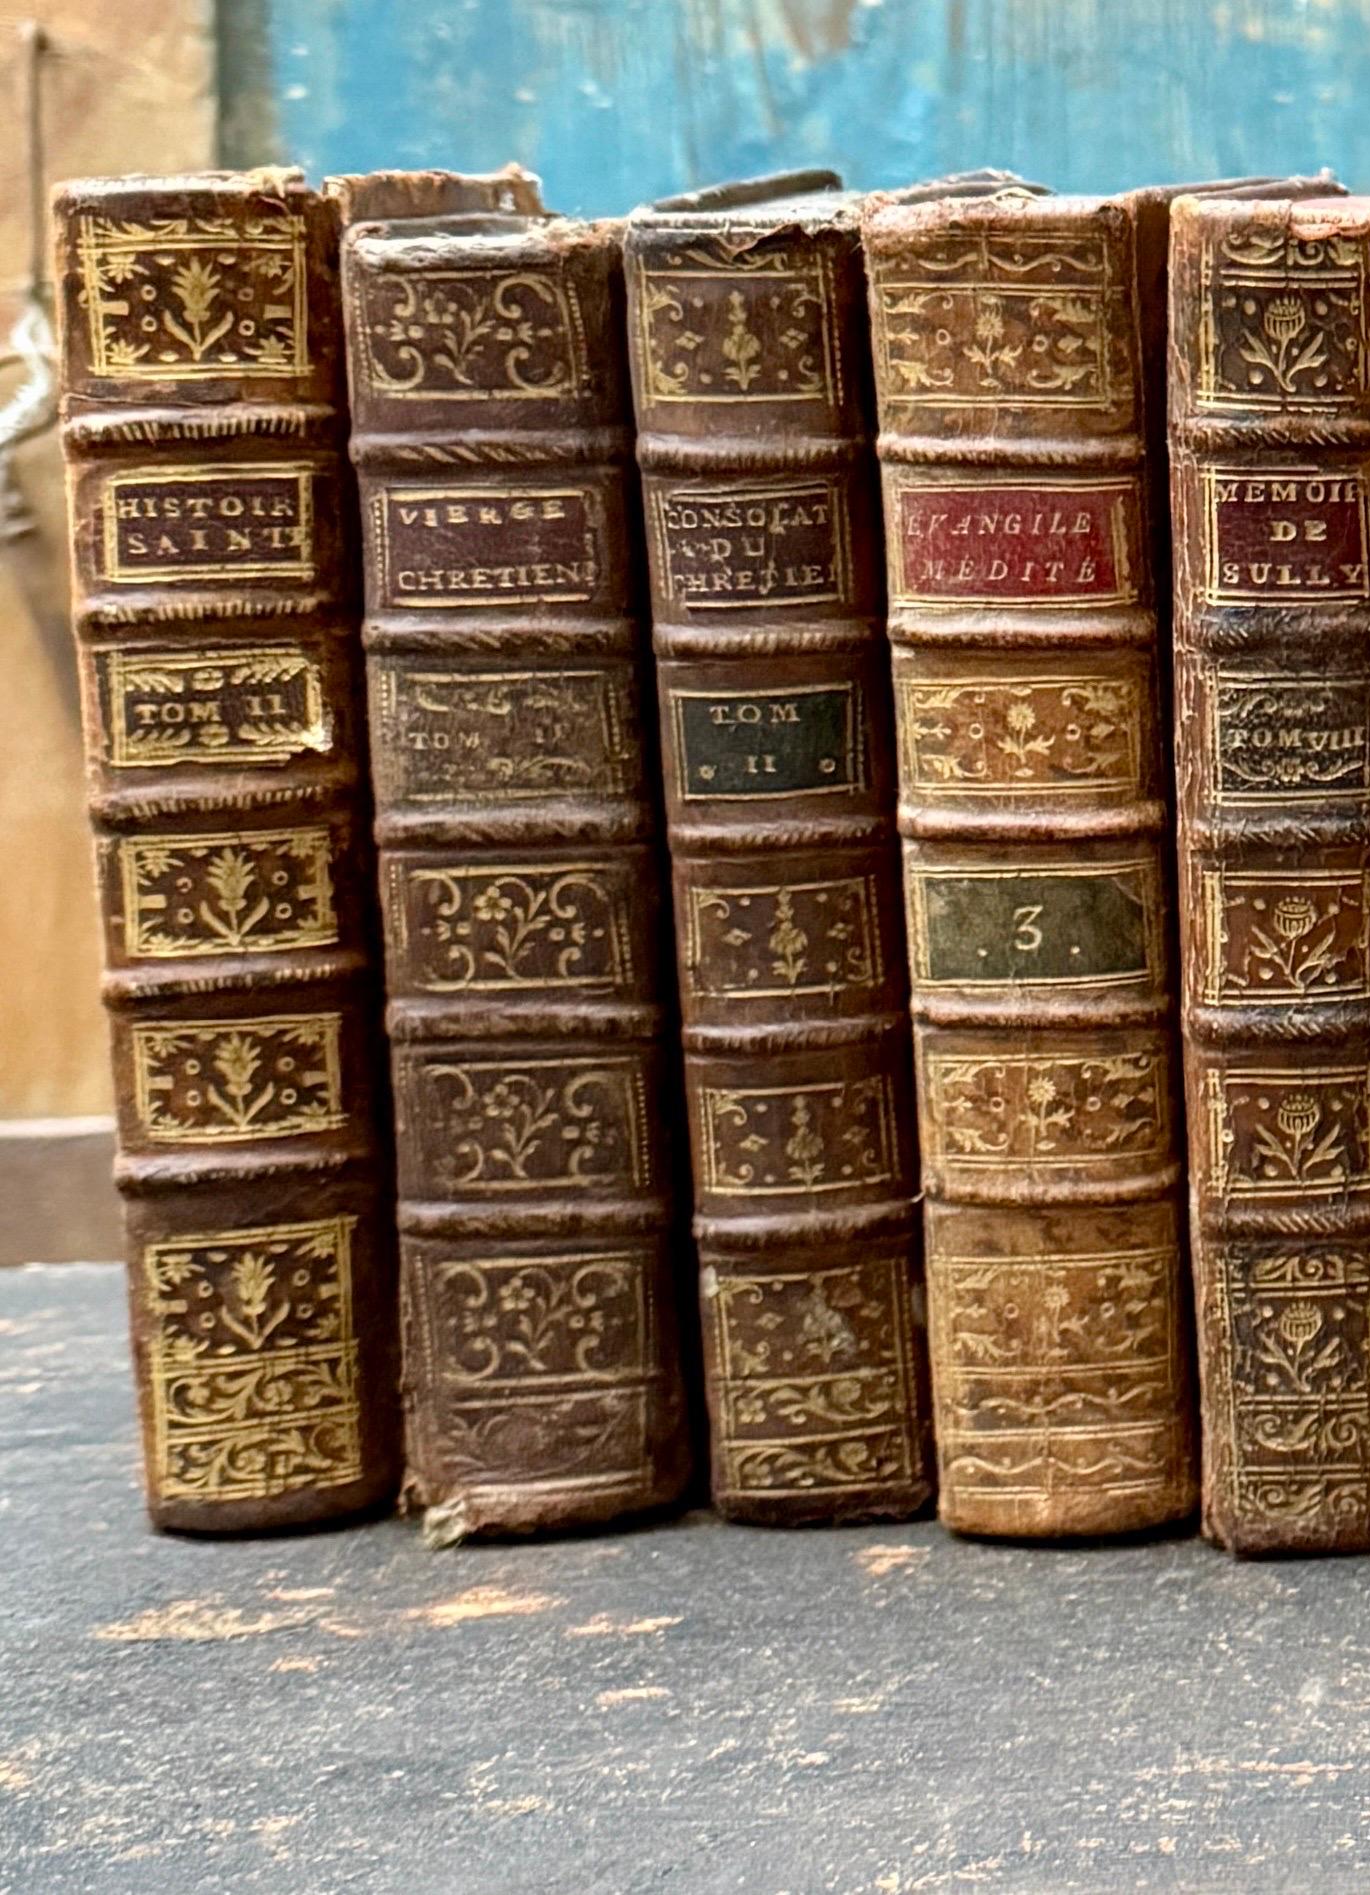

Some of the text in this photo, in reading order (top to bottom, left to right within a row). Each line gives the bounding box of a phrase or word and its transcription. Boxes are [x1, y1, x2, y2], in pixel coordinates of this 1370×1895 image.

[118, 496, 294, 519] HISTOIR
[1269, 519, 1327, 541] DE
[711, 537, 765, 558] DU
[1222, 562, 1362, 586] SULLY
[134, 694, 286, 725] TOM II
[709, 703, 800, 725] TOM
[746, 754, 776, 774] II
